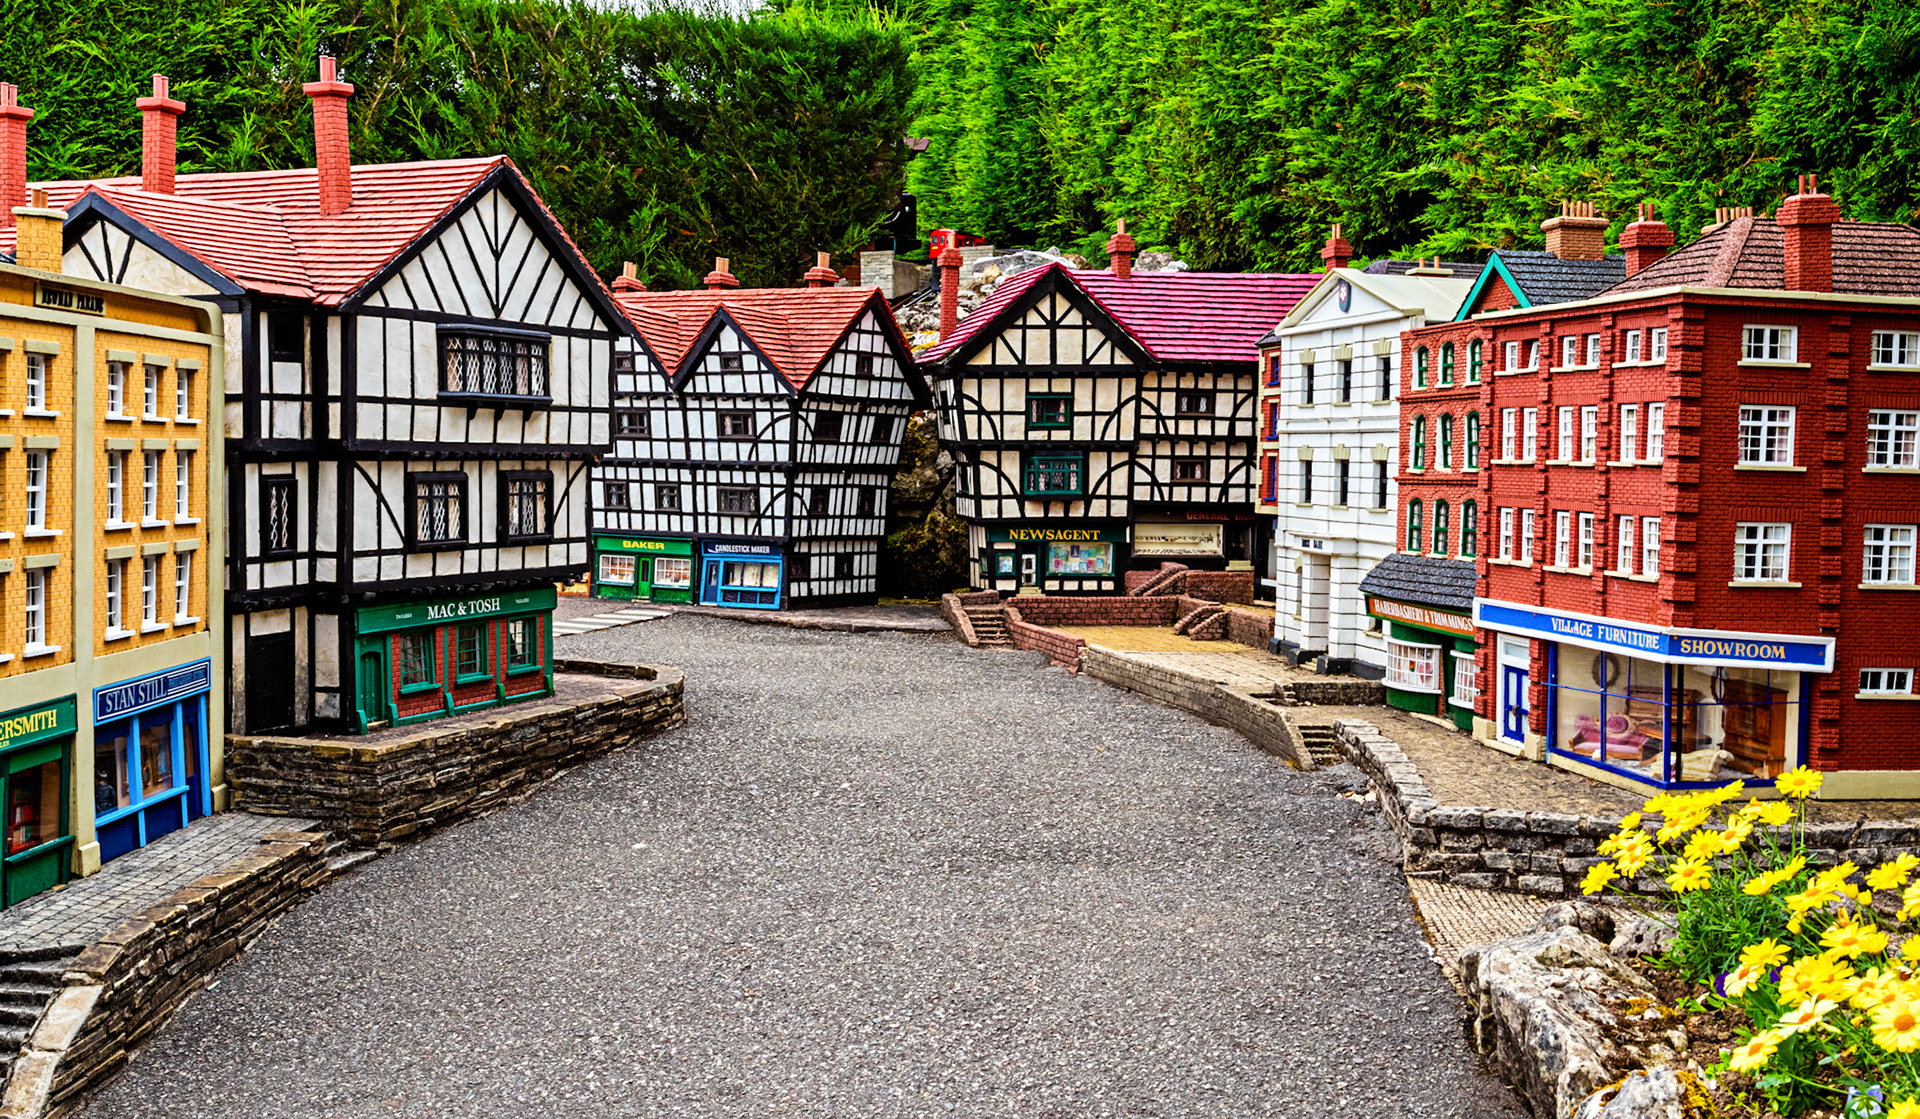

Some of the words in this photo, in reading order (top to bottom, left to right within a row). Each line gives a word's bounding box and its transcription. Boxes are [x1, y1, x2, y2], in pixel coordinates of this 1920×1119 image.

[1186, 510, 1230, 521] GENERAL
[1009, 528, 1101, 541] NEWSAGENT
[622, 540, 665, 550] BAKER
[715, 543, 751, 553] CANDLESTICK
[751, 545, 770, 553] MAKER
[427, 602, 456, 620] MAC
[457, 601, 467, 616] &
[468, 597, 501, 614] TOSH
[1374, 598, 1424, 622] HABERDASHERY
[1424, 609, 1431, 623] &
[1430, 610, 1474, 632] TRIMMINGS
[1551, 617, 1593, 638] VILLAGE
[1597, 625, 1660, 649] FURNITURE
[1680, 638, 1787, 660] SHOWROOM
[105, 685, 136, 713] STAN
[138, 677, 167, 704] STILL
